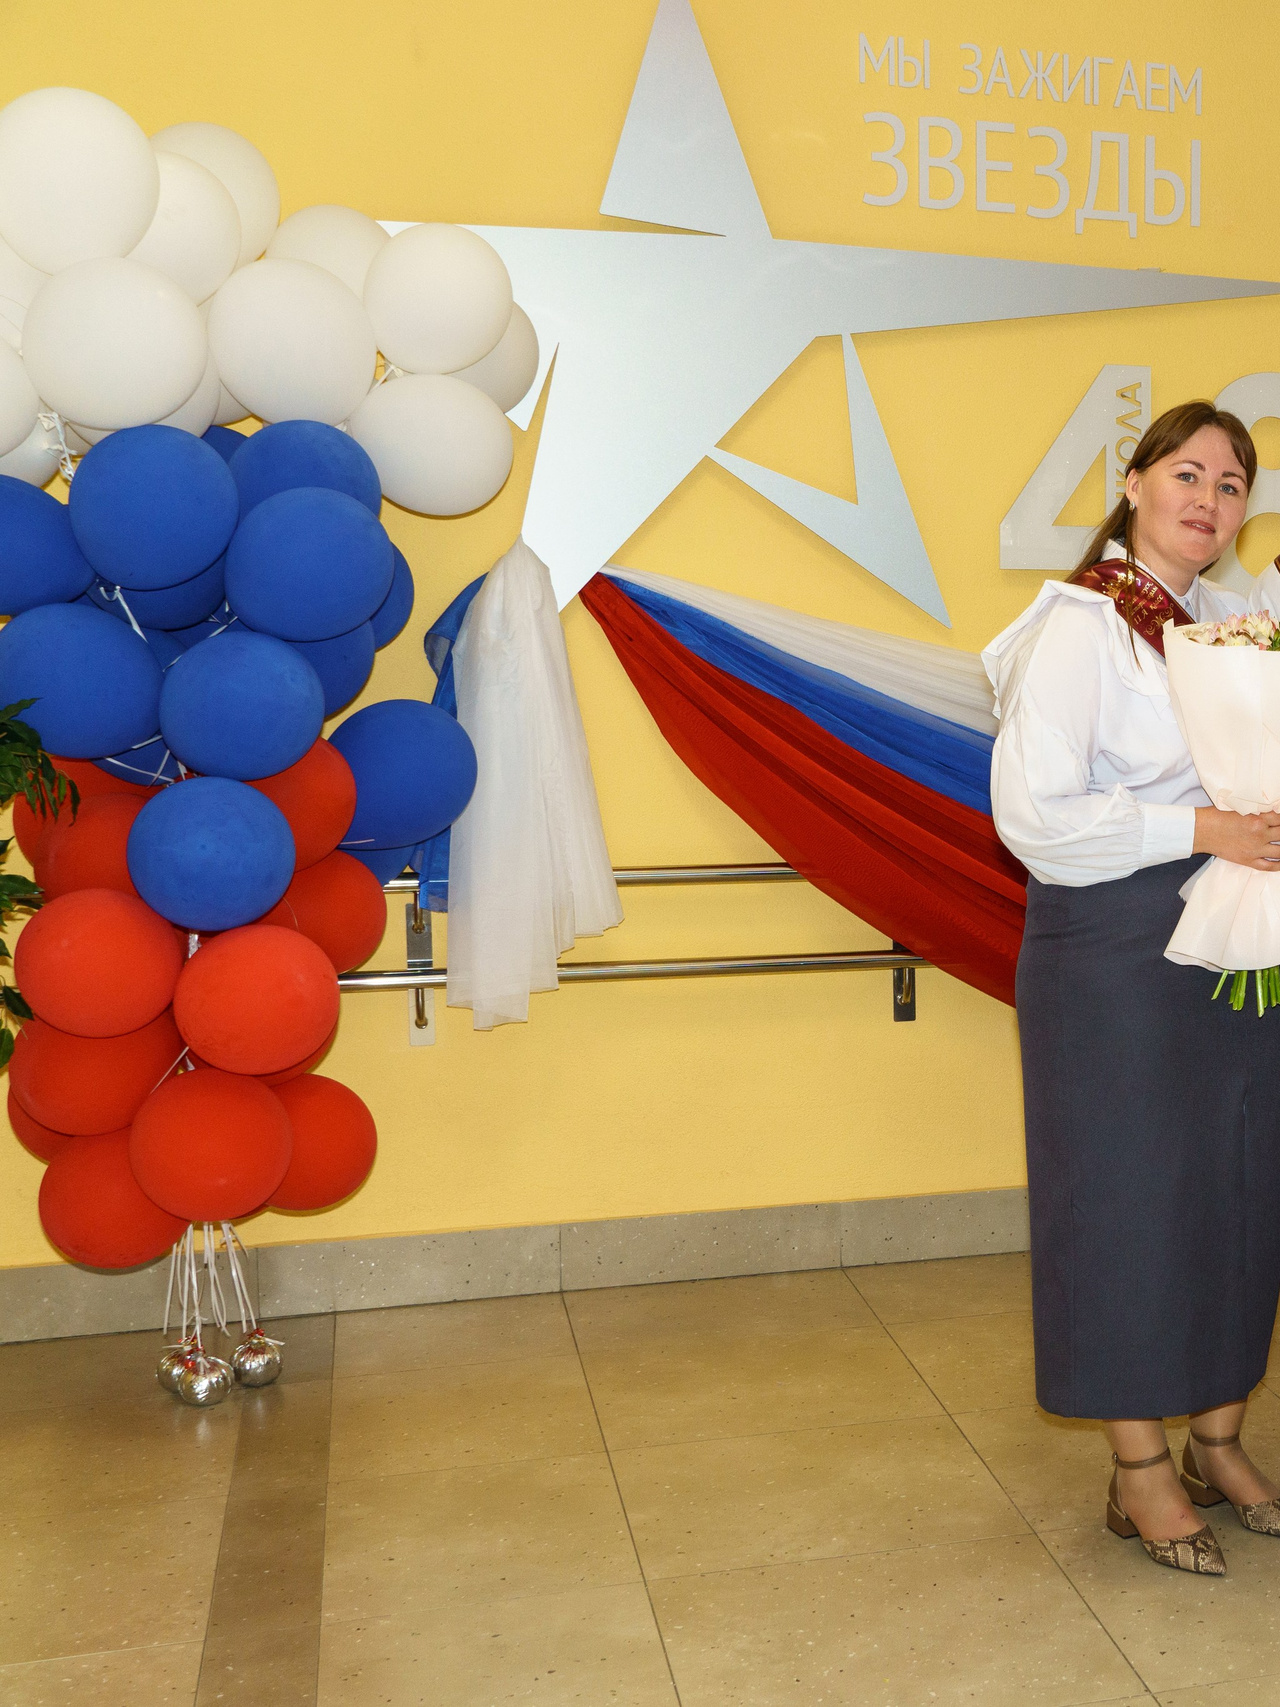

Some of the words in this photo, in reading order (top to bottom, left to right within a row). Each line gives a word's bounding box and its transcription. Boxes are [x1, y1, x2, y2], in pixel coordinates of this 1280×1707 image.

[859, 33, 931, 90] МЫ
[959, 42, 1203, 115] ЗАЖИГАЕМ
[861, 110, 1202, 238] ЗВЕЗДЫ
